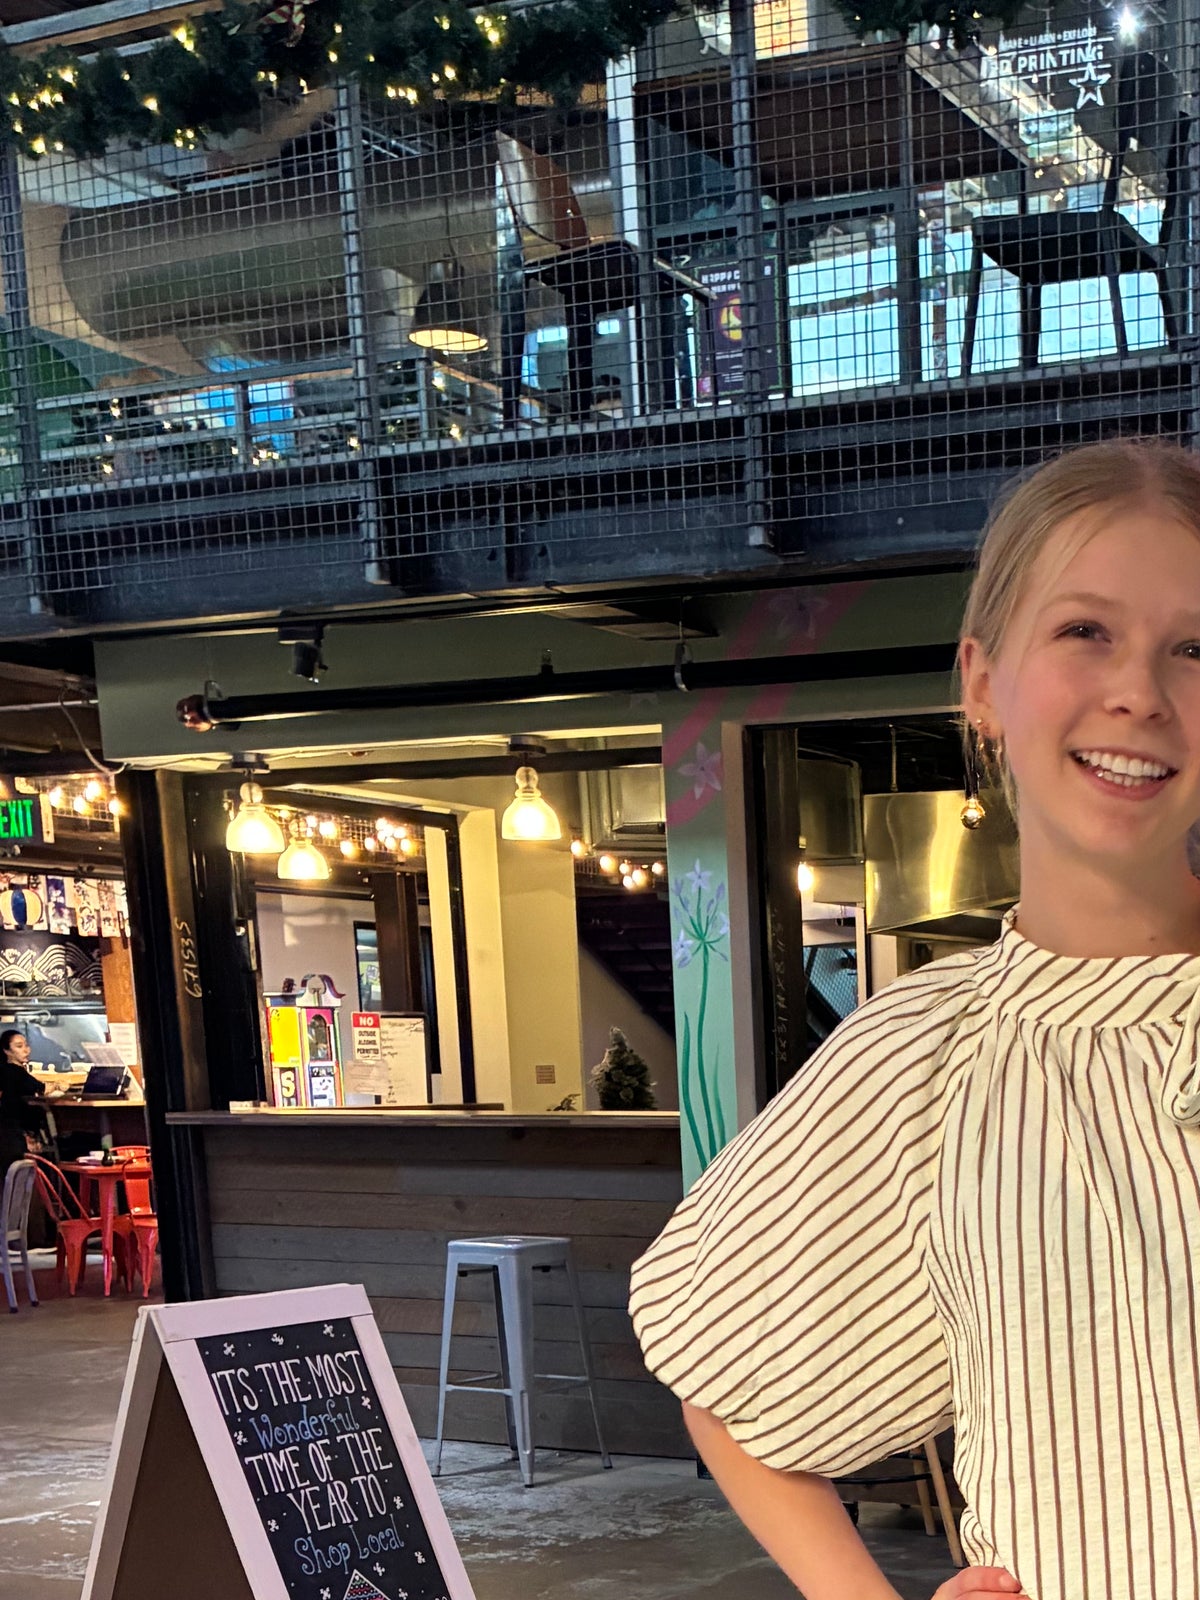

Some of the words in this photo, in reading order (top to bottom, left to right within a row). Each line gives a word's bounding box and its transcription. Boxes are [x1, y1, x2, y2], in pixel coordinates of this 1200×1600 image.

[1017, 44, 1104, 73] PRINTING
[0, 800, 33, 838] EXIT
[359, 1016, 374, 1027] NO
[254, 1358, 312, 1407] THE
[305, 1350, 367, 1400] MOST
[249, 1397, 360, 1449] Wonderful
[244, 1447, 310, 1496] TIME
[308, 1439, 335, 1482] OF
[336, 1428, 393, 1475] THE
[287, 1480, 358, 1534] YEAR
[351, 1474, 387, 1518] TO
[294, 1535, 351, 1576] Shop
[349, 1513, 405, 1559] Local
